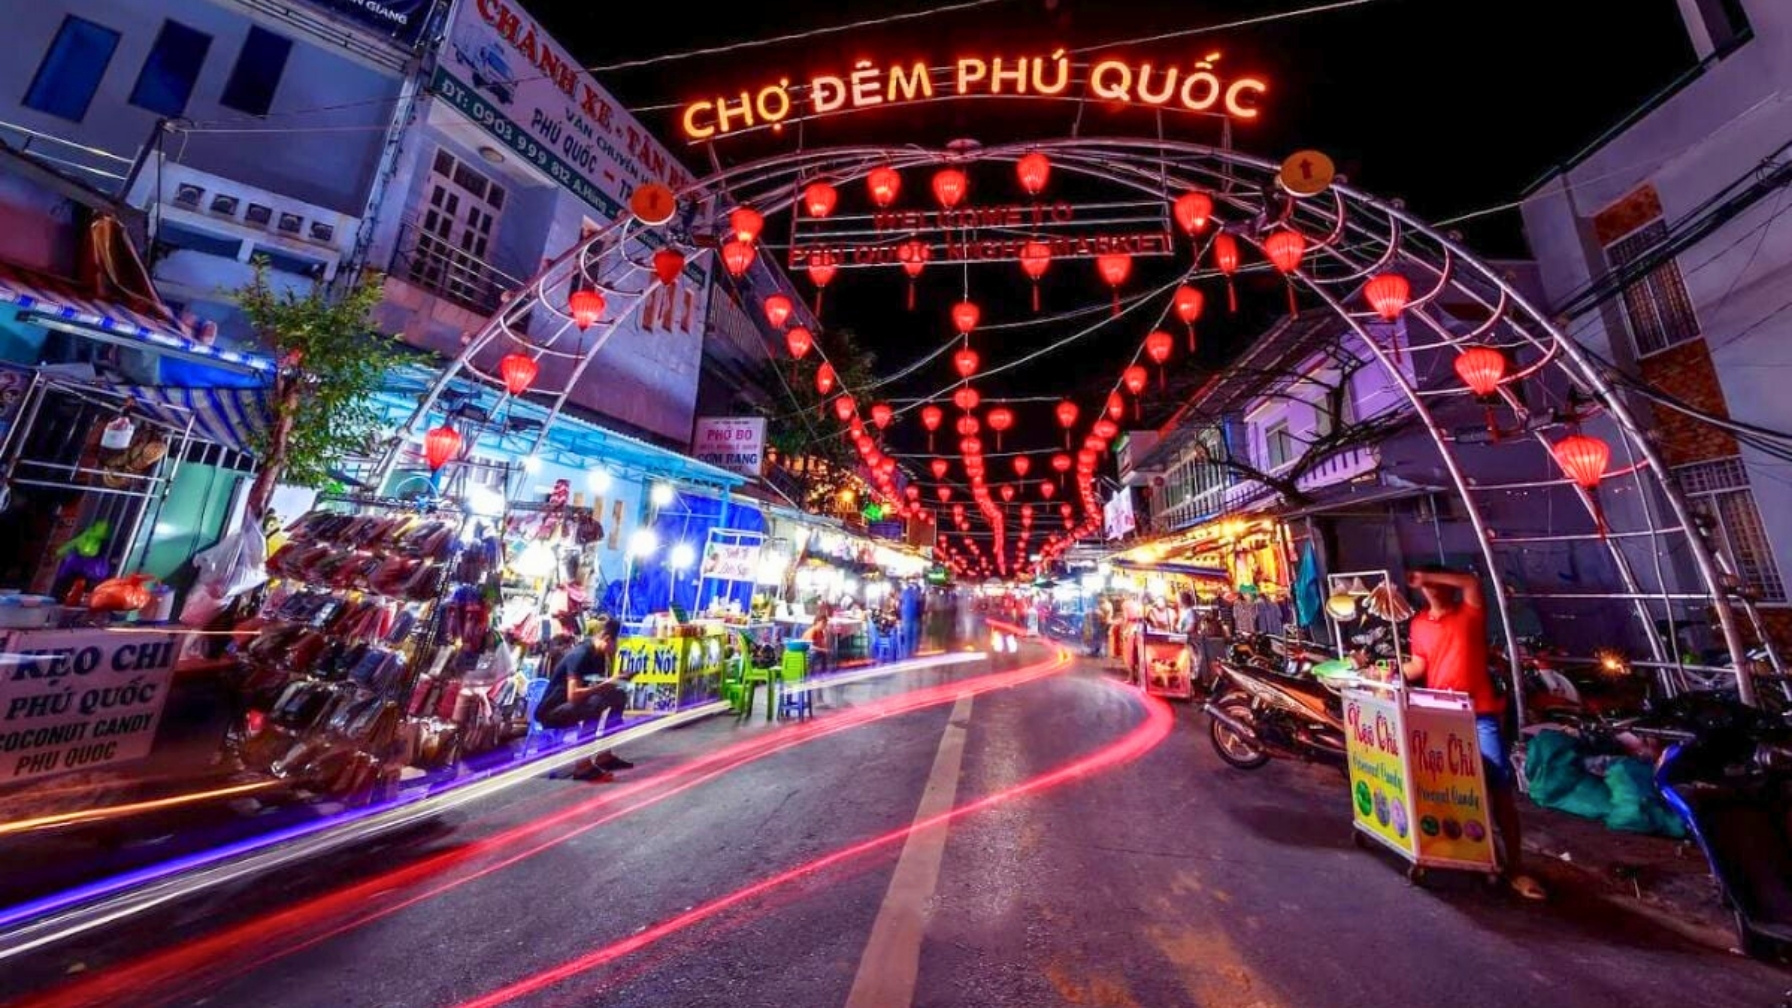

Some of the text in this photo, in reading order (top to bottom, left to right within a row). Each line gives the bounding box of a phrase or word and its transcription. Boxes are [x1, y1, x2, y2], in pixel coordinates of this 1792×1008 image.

[365, 1, 407, 25] GIANG
[476, 0, 580, 101] CHÀNH
[682, 48, 1266, 138] CHỢ ĐÊM PHÚ QUỐC
[441, 78, 469, 108] ĐT:
[472, 102, 512, 140] 0903
[517, 136, 548, 165] 999
[531, 107, 563, 145] PHÚ
[562, 134, 597, 174] QUỐC
[1032, 202, 1074, 227] TO
[1051, 234, 1174, 258] MARKET
[10, 645, 104, 687] KẸO
[652, 645, 678, 675] Nốt
[5, 675, 158, 720] PHÚ QUỐC
[93, 713, 155, 738] CANDY
